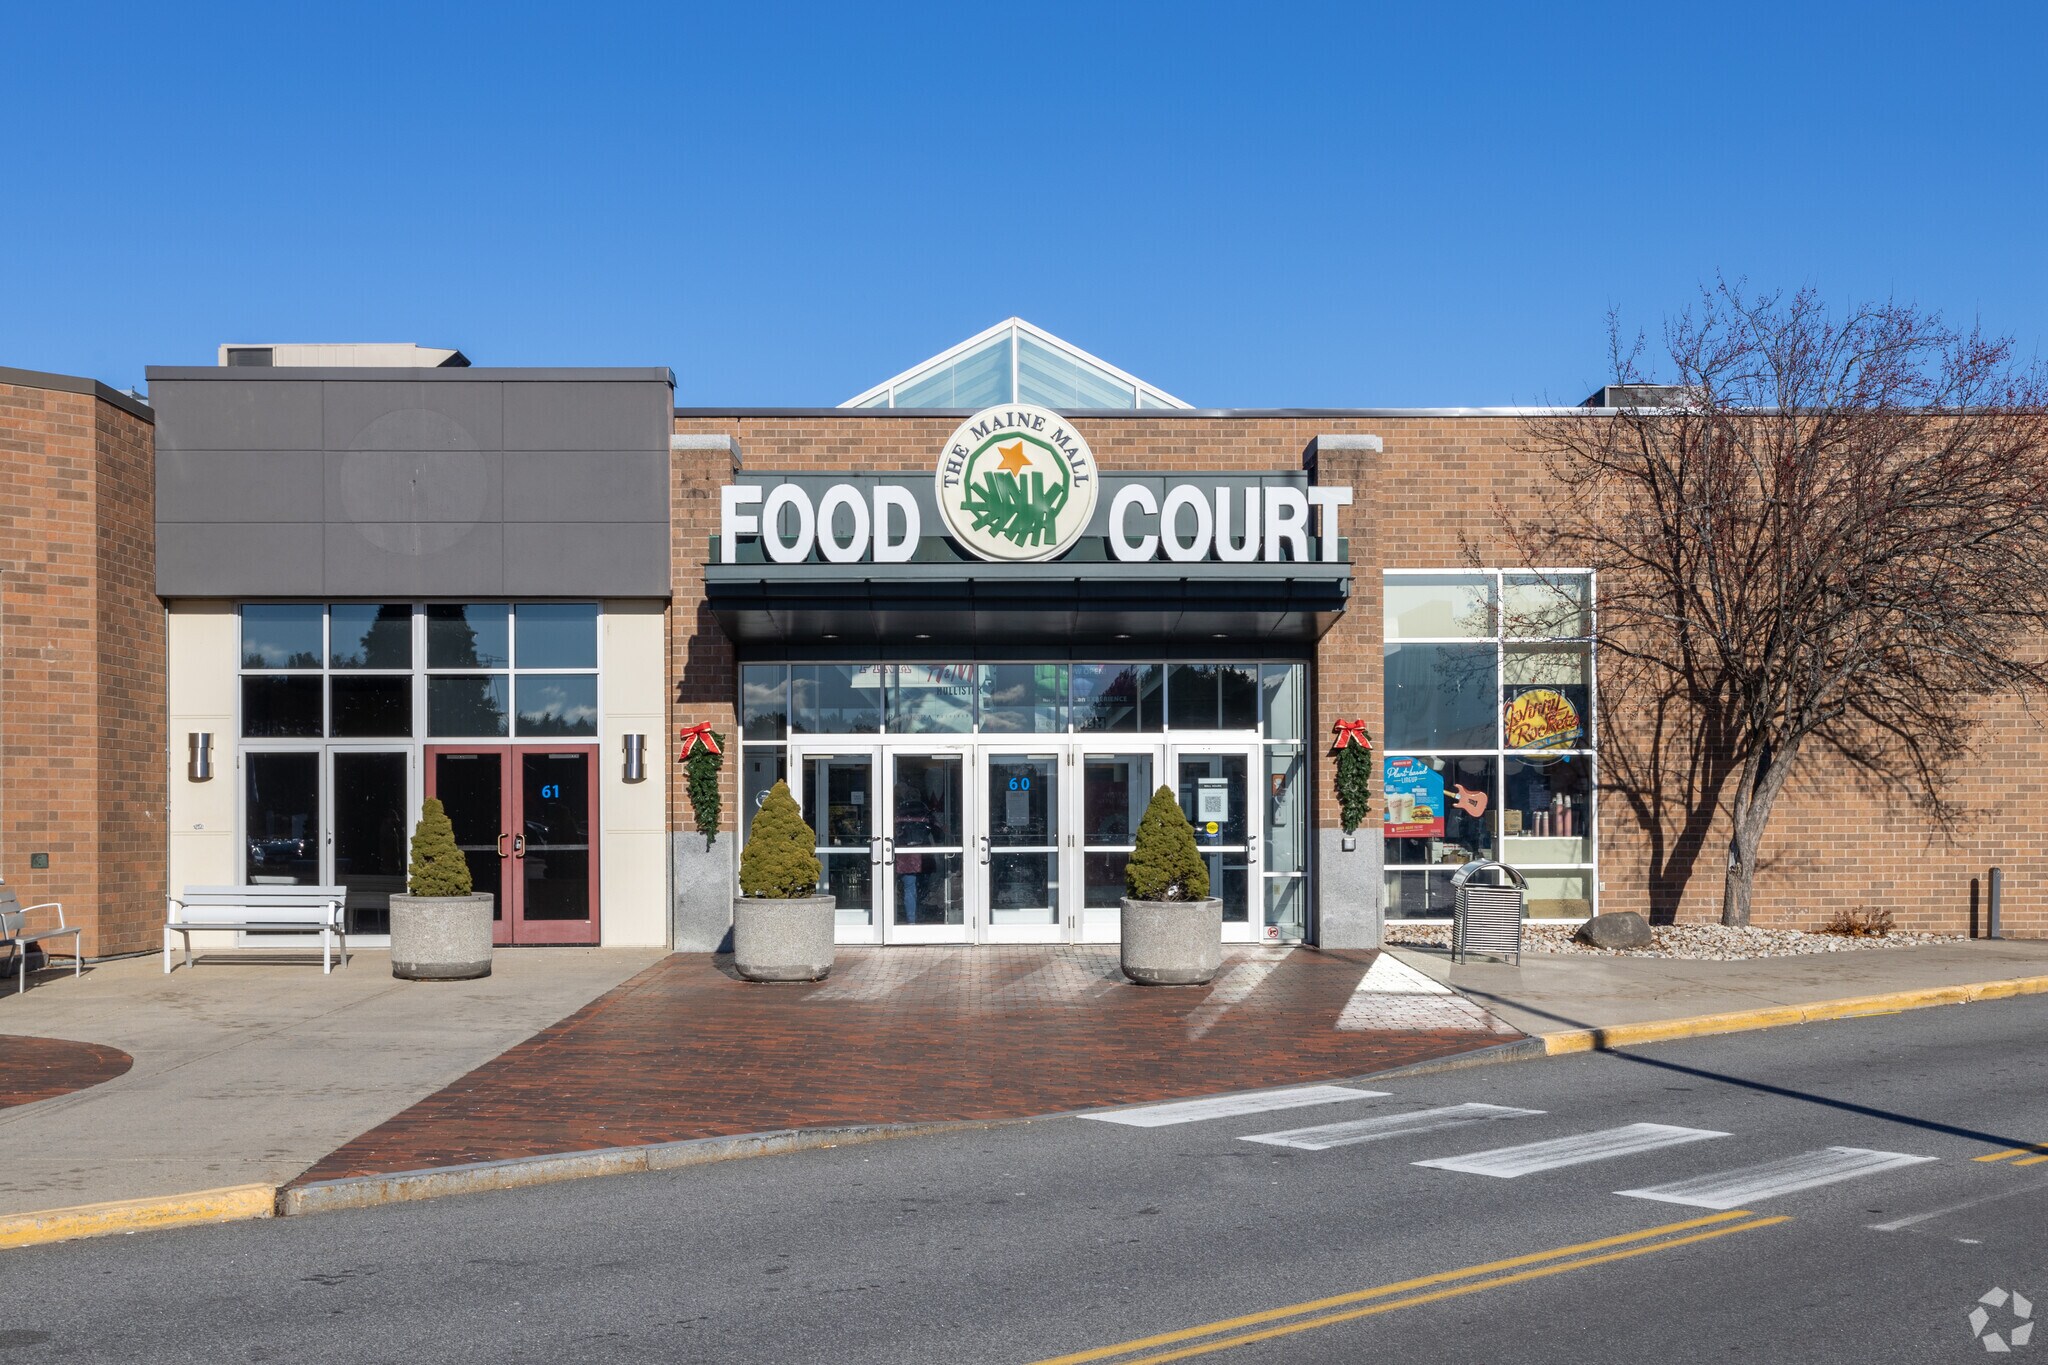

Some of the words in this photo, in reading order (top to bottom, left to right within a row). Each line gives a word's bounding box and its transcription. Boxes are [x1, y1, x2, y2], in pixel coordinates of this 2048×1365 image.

[944, 444, 970, 489] THE
[970, 411, 1047, 442] MAINE
[1050, 426, 1090, 489] MALL
[721, 483, 921, 564] FOOD
[1108, 483, 1354, 563] COURT
[936, 686, 983, 696] HOLLISTR
[1503, 694, 1568, 748] Johnny
[1512, 711, 1580, 749] Rockets
[1009, 777, 1031, 791] 60
[1386, 765, 1428, 779] Plant-based
[541, 784, 559, 799] 61
